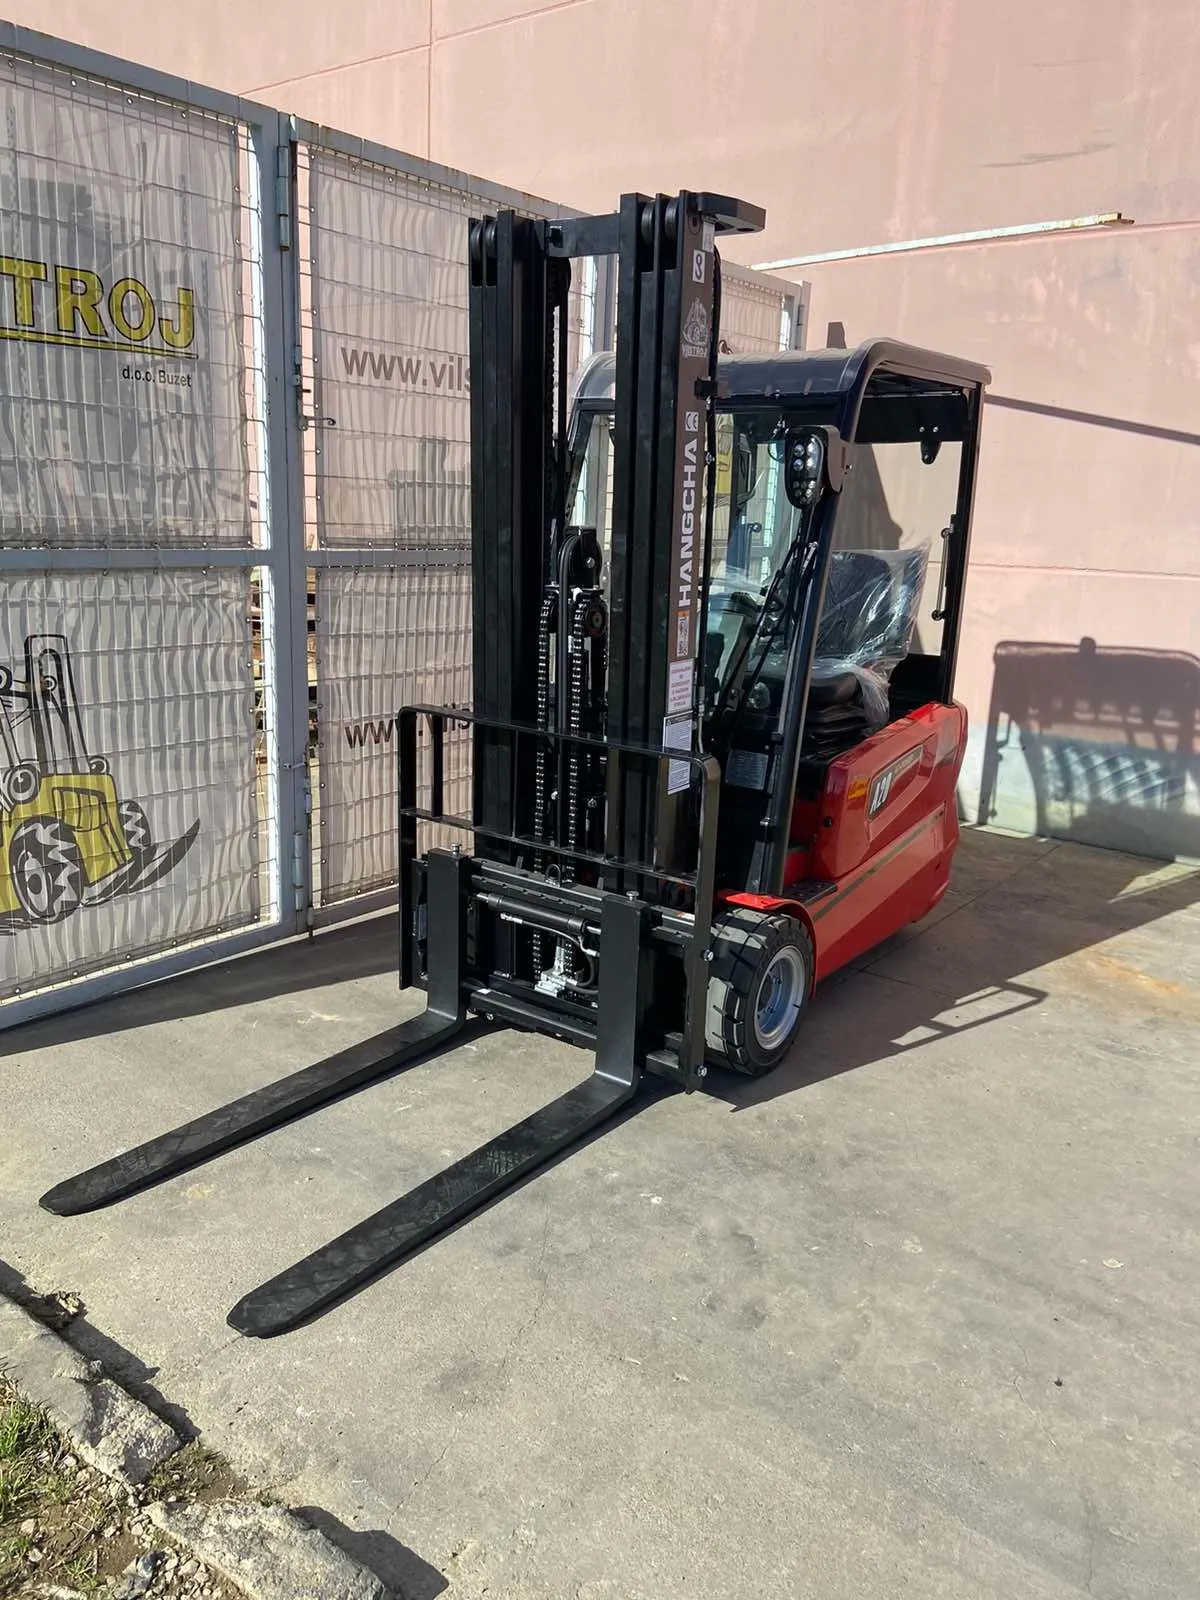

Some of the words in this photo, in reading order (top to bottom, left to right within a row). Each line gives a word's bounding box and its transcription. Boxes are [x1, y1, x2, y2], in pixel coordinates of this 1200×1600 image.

[122, 364, 156, 383] d.o.o.
[158, 370, 192, 387] Buzet
[678, 438, 698, 607] HANGCHA
